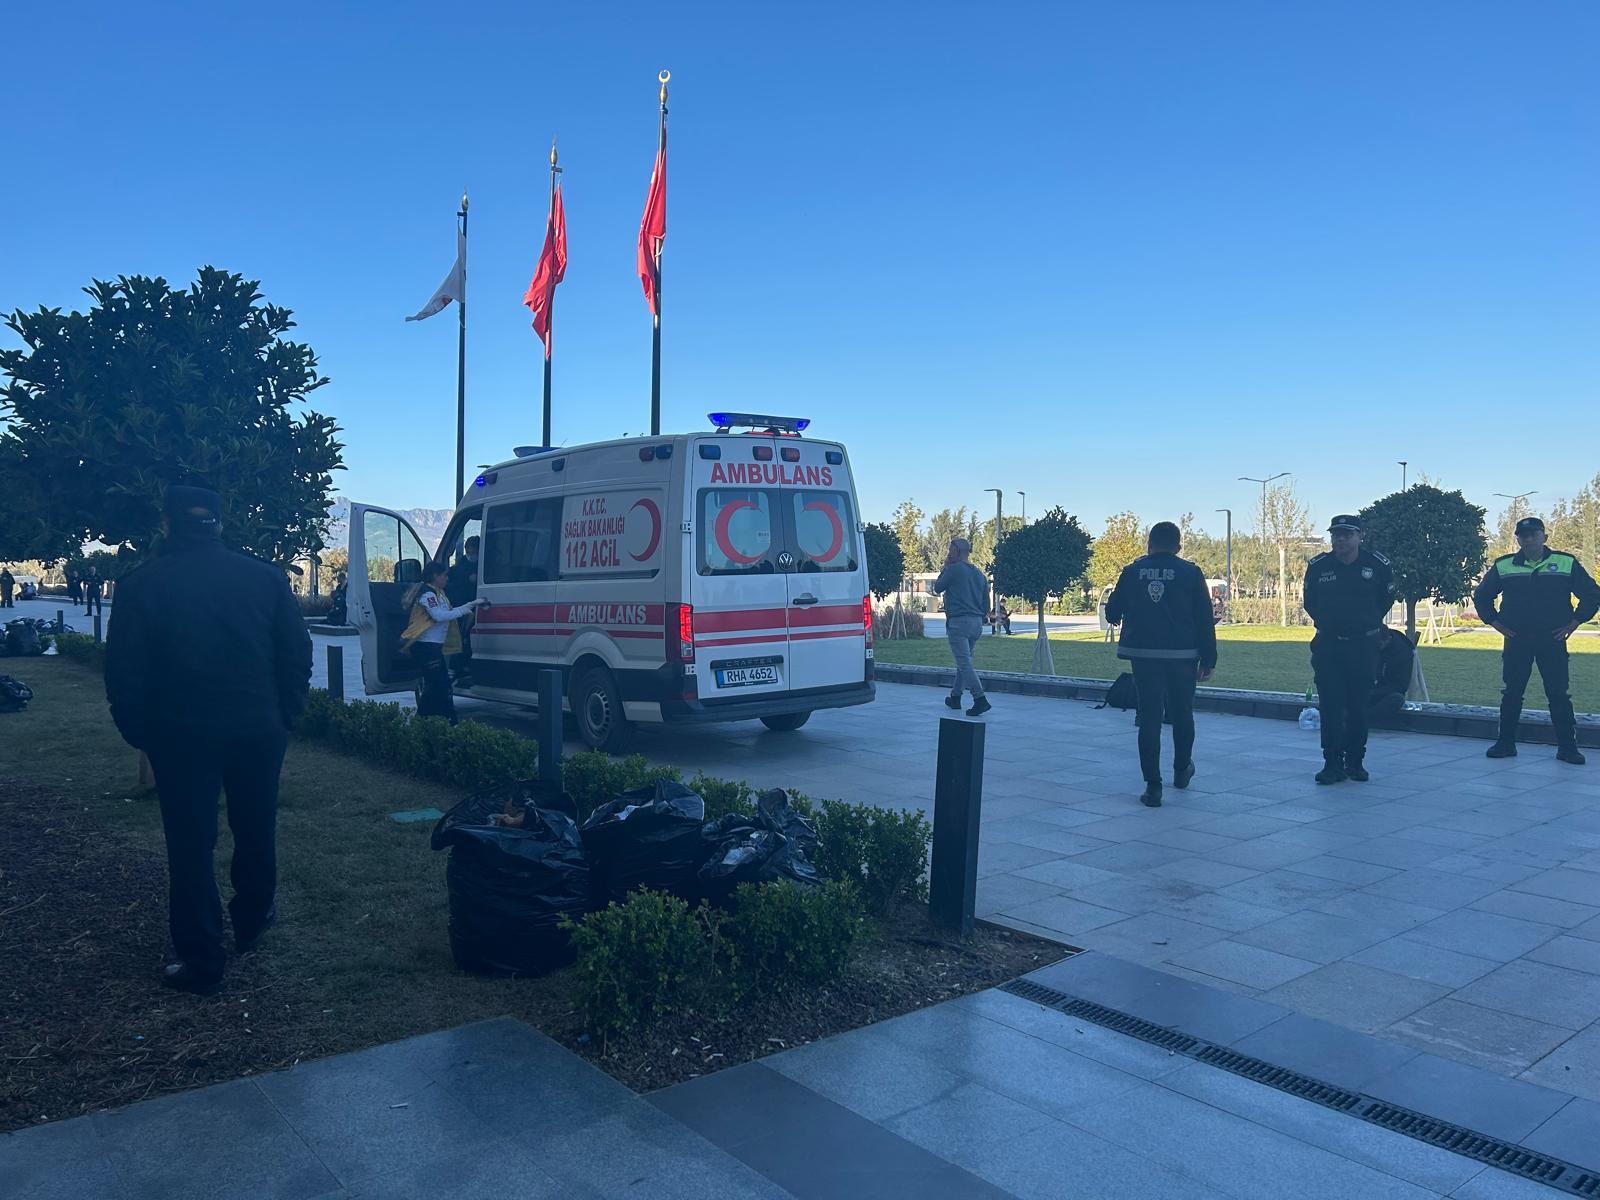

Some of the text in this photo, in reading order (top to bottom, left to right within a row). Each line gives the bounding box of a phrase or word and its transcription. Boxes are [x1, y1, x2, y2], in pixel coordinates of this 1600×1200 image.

[710, 462, 833, 487] AMBULANS
[564, 518, 588, 539] SAĞLIK
[566, 541, 587, 568] 112
[568, 605, 647, 624] AMBULANS
[727, 667, 773, 683] RHA 4652
